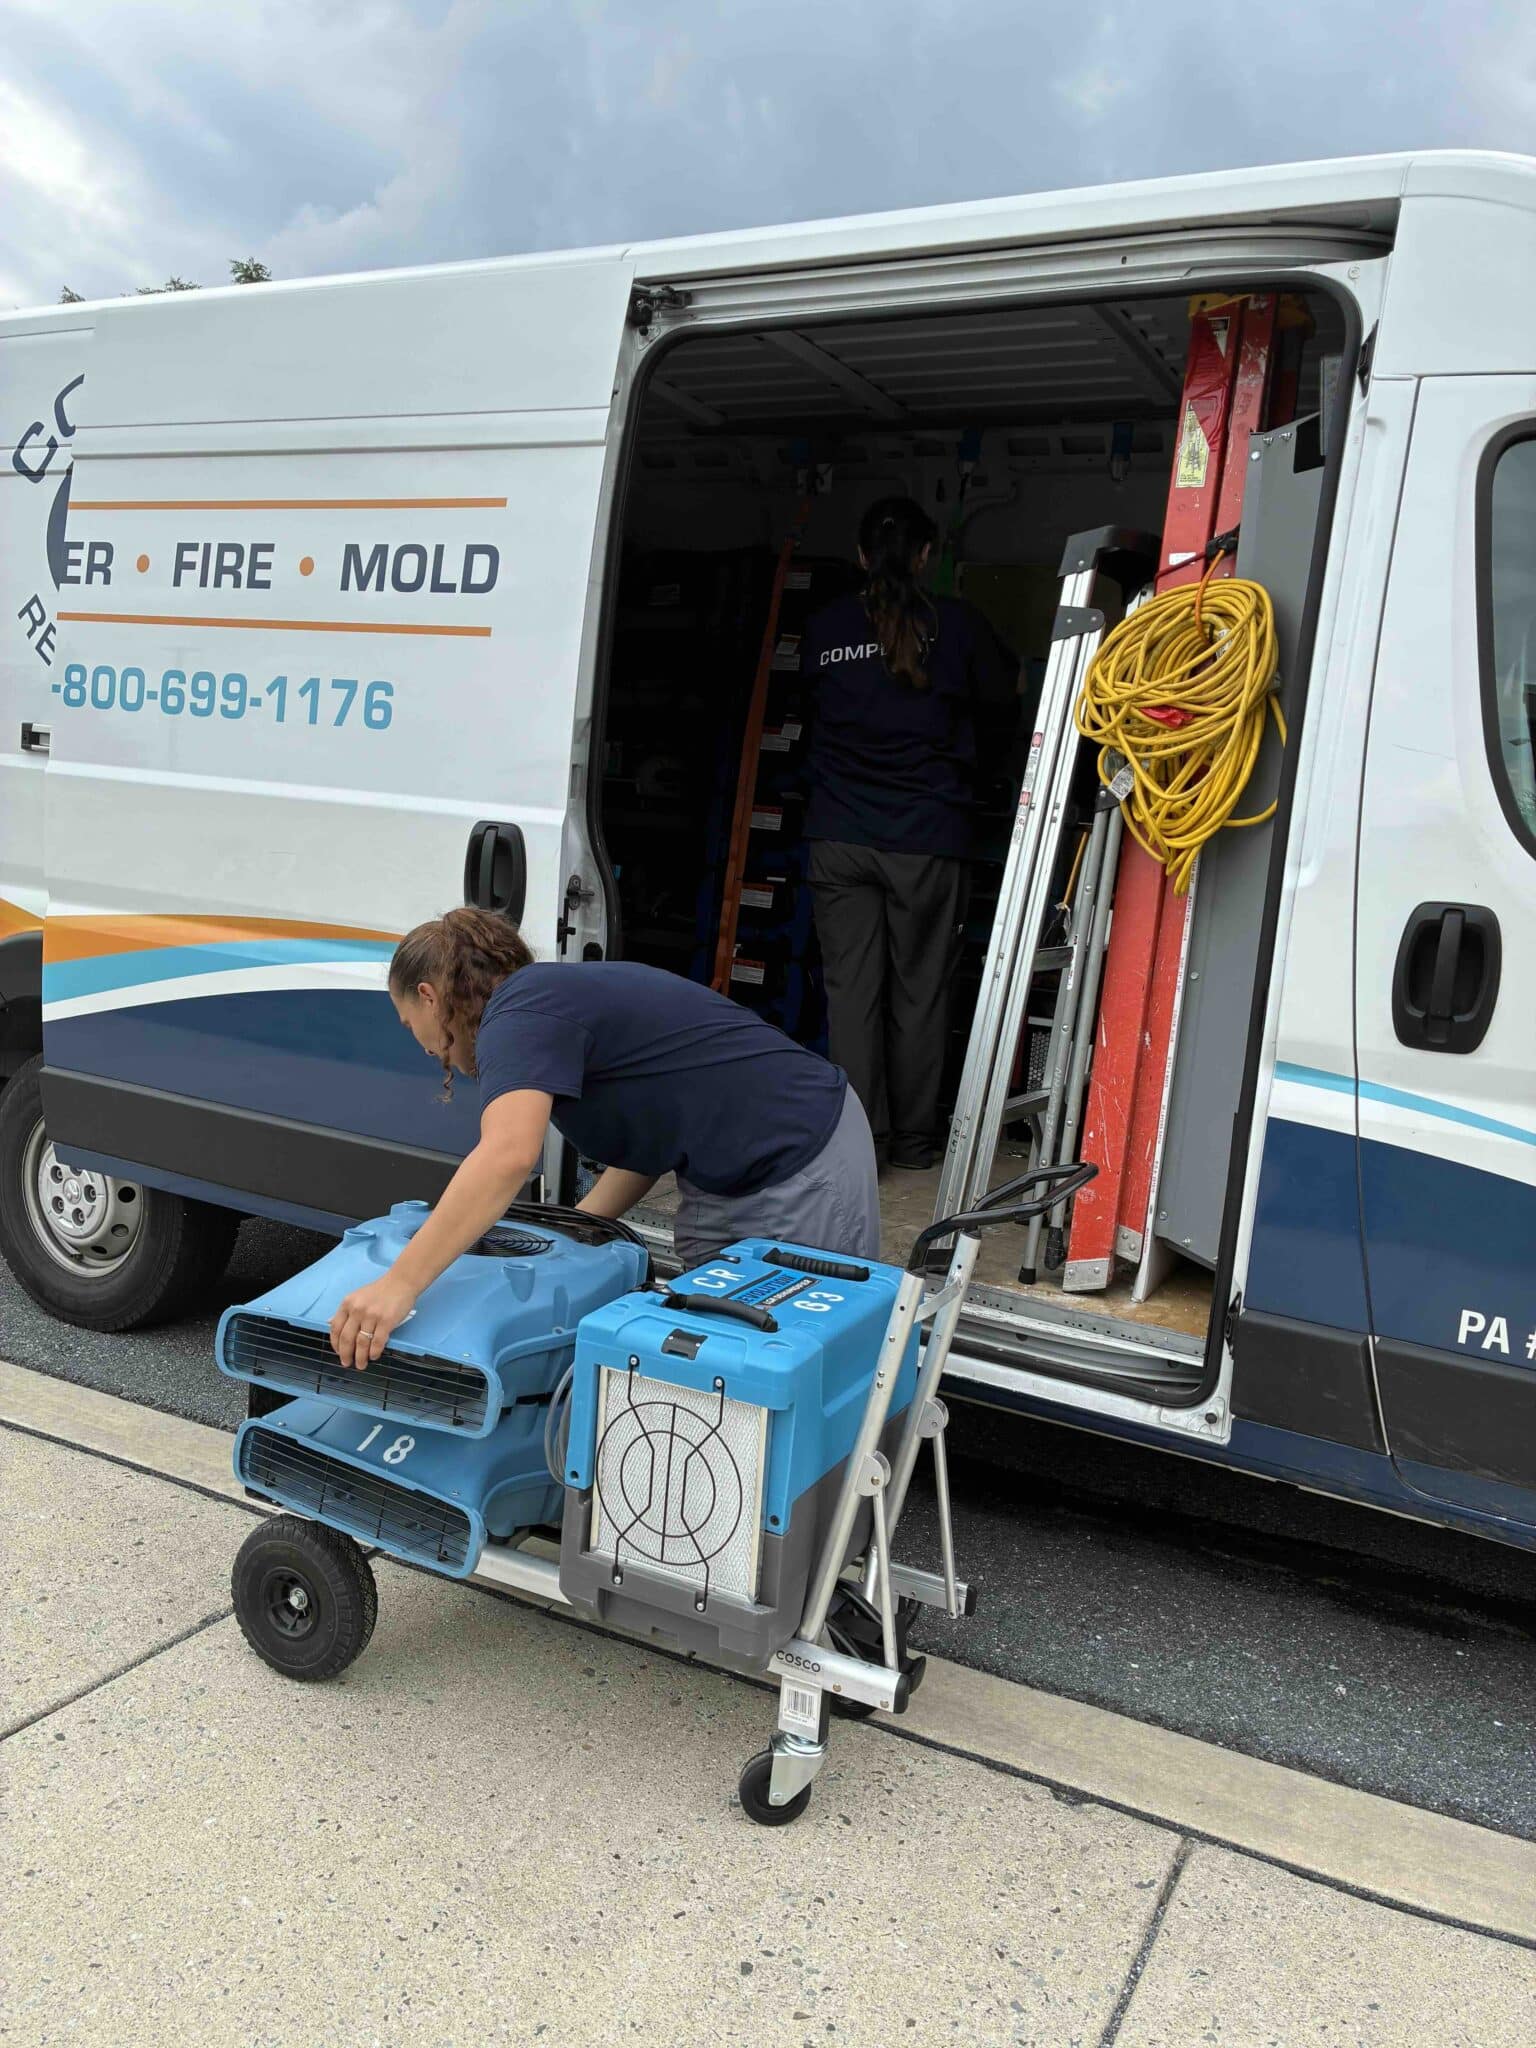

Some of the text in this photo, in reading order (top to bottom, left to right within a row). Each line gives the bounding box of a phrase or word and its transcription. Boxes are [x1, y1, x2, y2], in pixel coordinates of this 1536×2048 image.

[172, 543, 275, 589] FIRE
[340, 543, 500, 594] MOLD
[692, 1268, 747, 1289] CR
[1457, 1308, 1510, 1355] PA
[775, 1650, 821, 1673] COSCO
